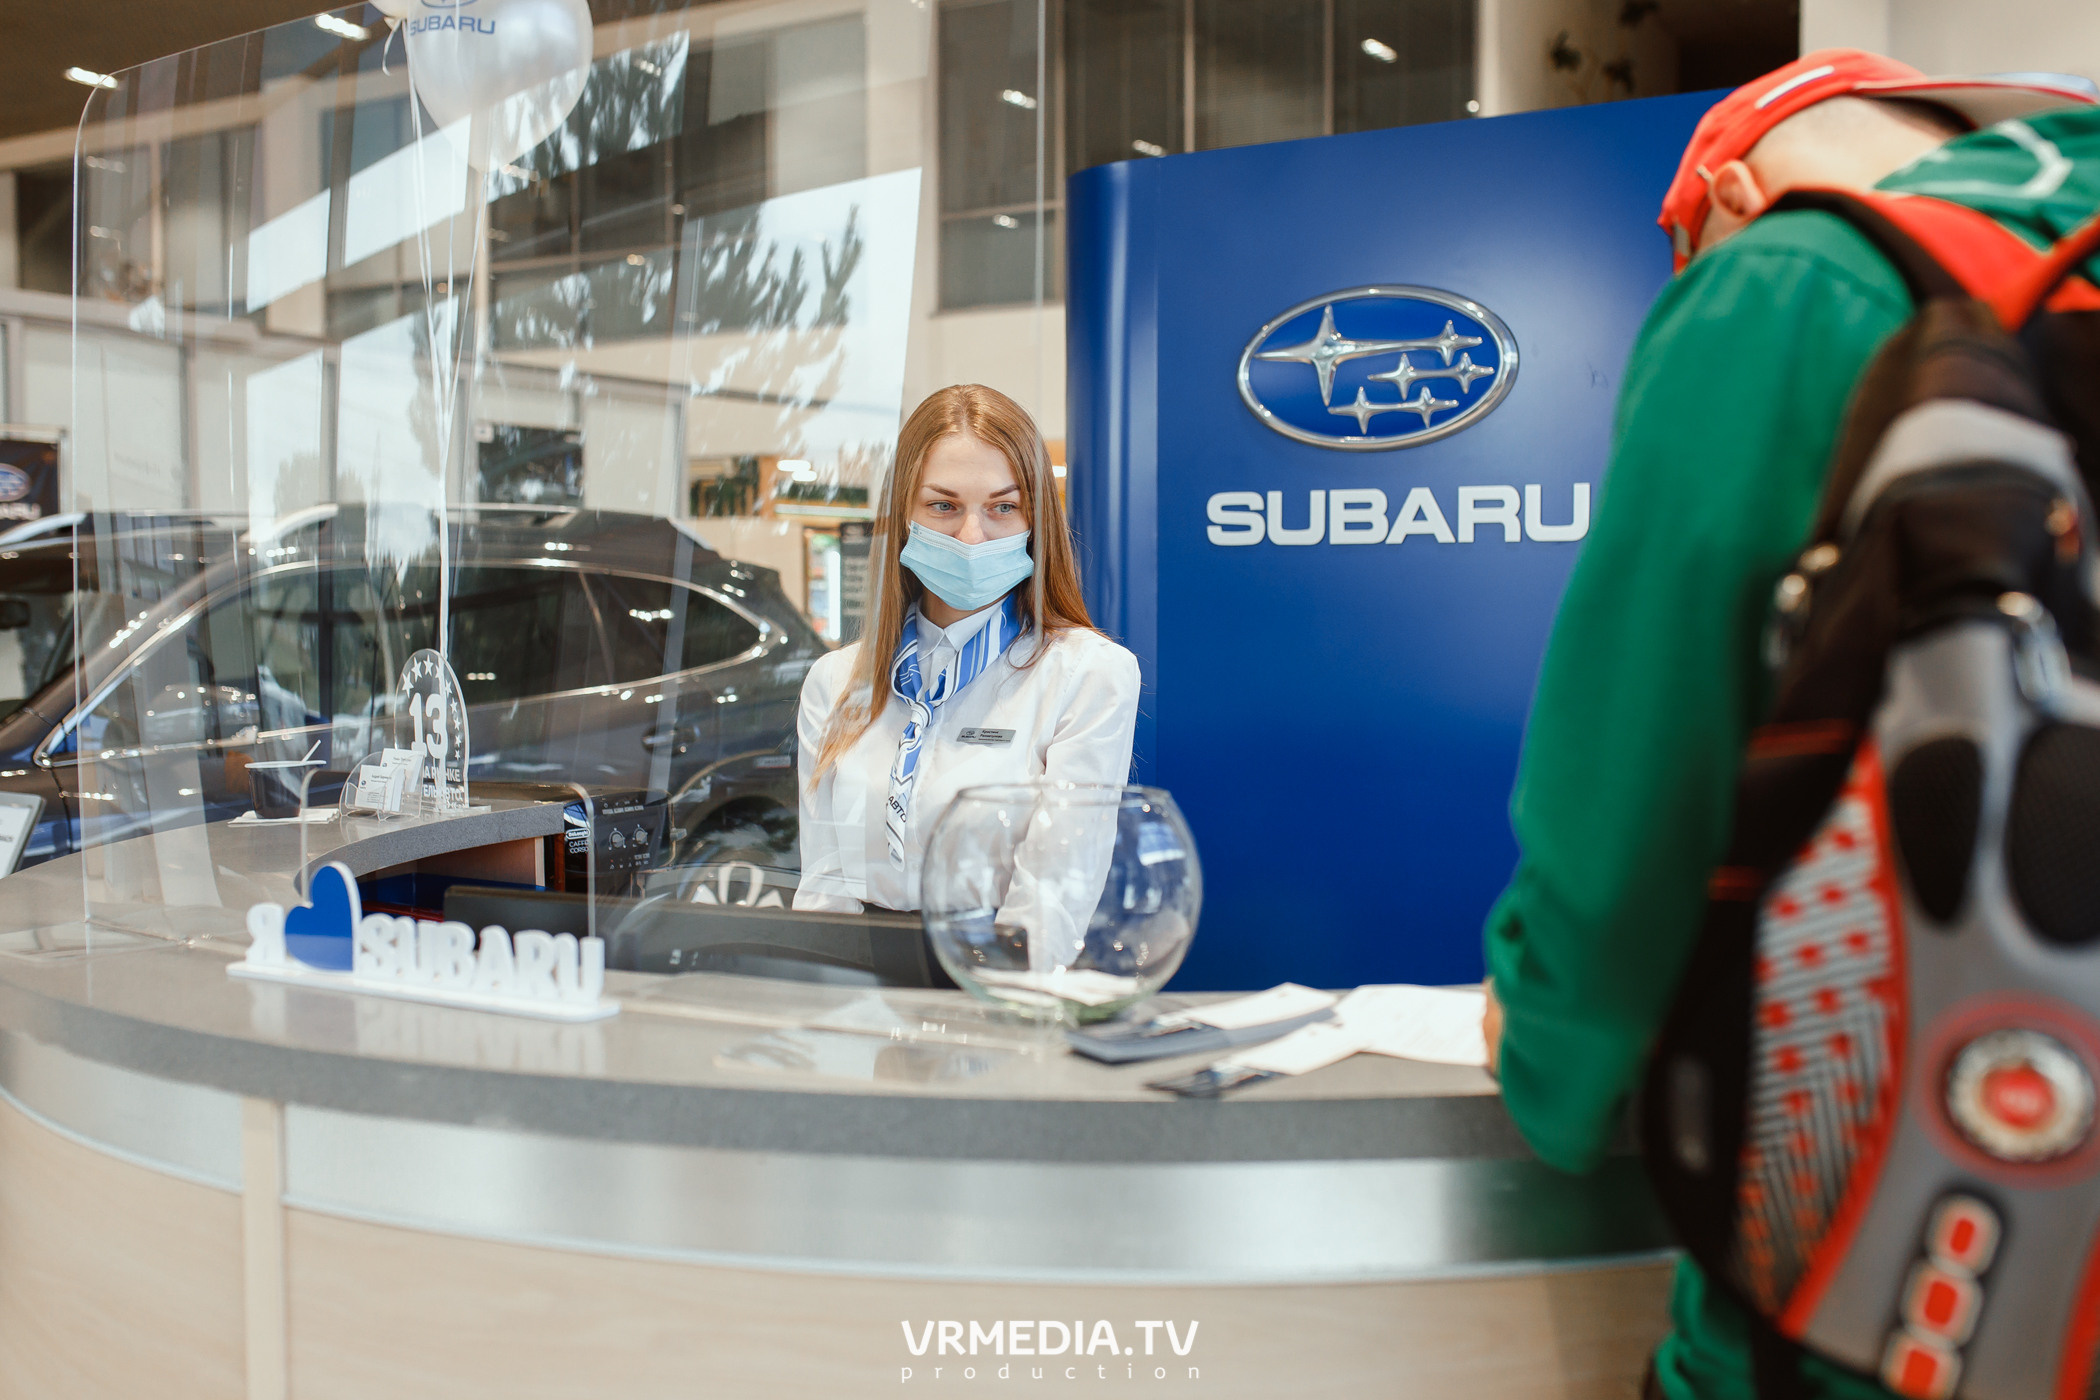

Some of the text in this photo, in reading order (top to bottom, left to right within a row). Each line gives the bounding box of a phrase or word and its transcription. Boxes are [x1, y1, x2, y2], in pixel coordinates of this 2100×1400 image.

[409, 15, 496, 36] SUBARU
[1205, 482, 1592, 547] SUBARU
[408, 692, 448, 760] 13
[888, 795, 907, 823] АВТО
[245, 902, 606, 1005] Я SUBARU
